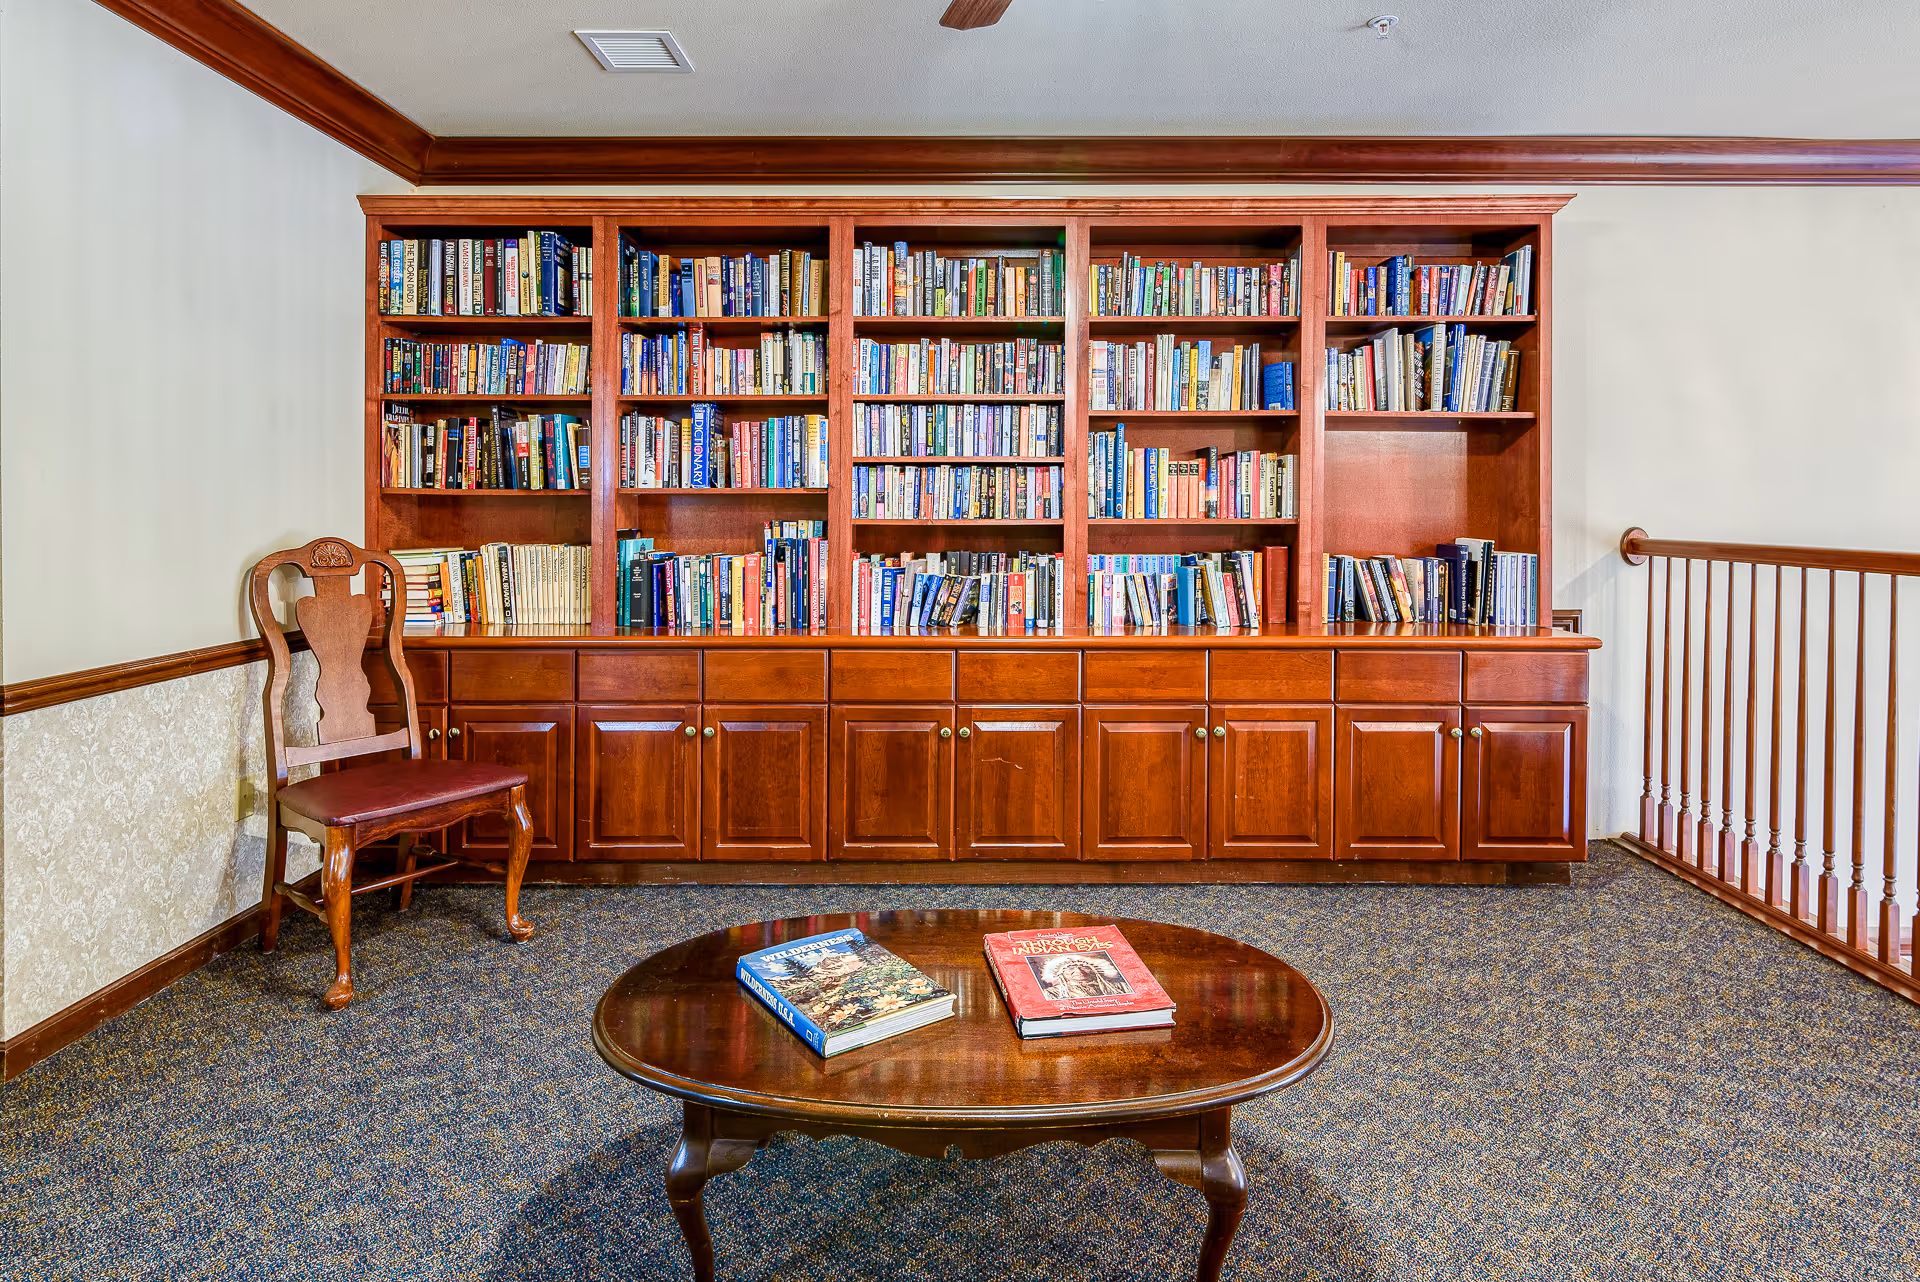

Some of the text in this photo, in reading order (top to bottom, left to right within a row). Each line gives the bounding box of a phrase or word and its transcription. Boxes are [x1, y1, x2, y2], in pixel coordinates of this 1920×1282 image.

[690, 347, 700, 368] Clancy
[693, 420, 704, 484] DICTIONARY
[501, 561, 510, 608] ANIMAL BEHAVIOR
[760, 934, 854, 963] WILDERNESS
[1012, 940, 1114, 955] INDIAN EYES
[1016, 936, 1098, 948] THROUGH
[740, 967, 795, 1027] WILDERNESS U.S.A.
